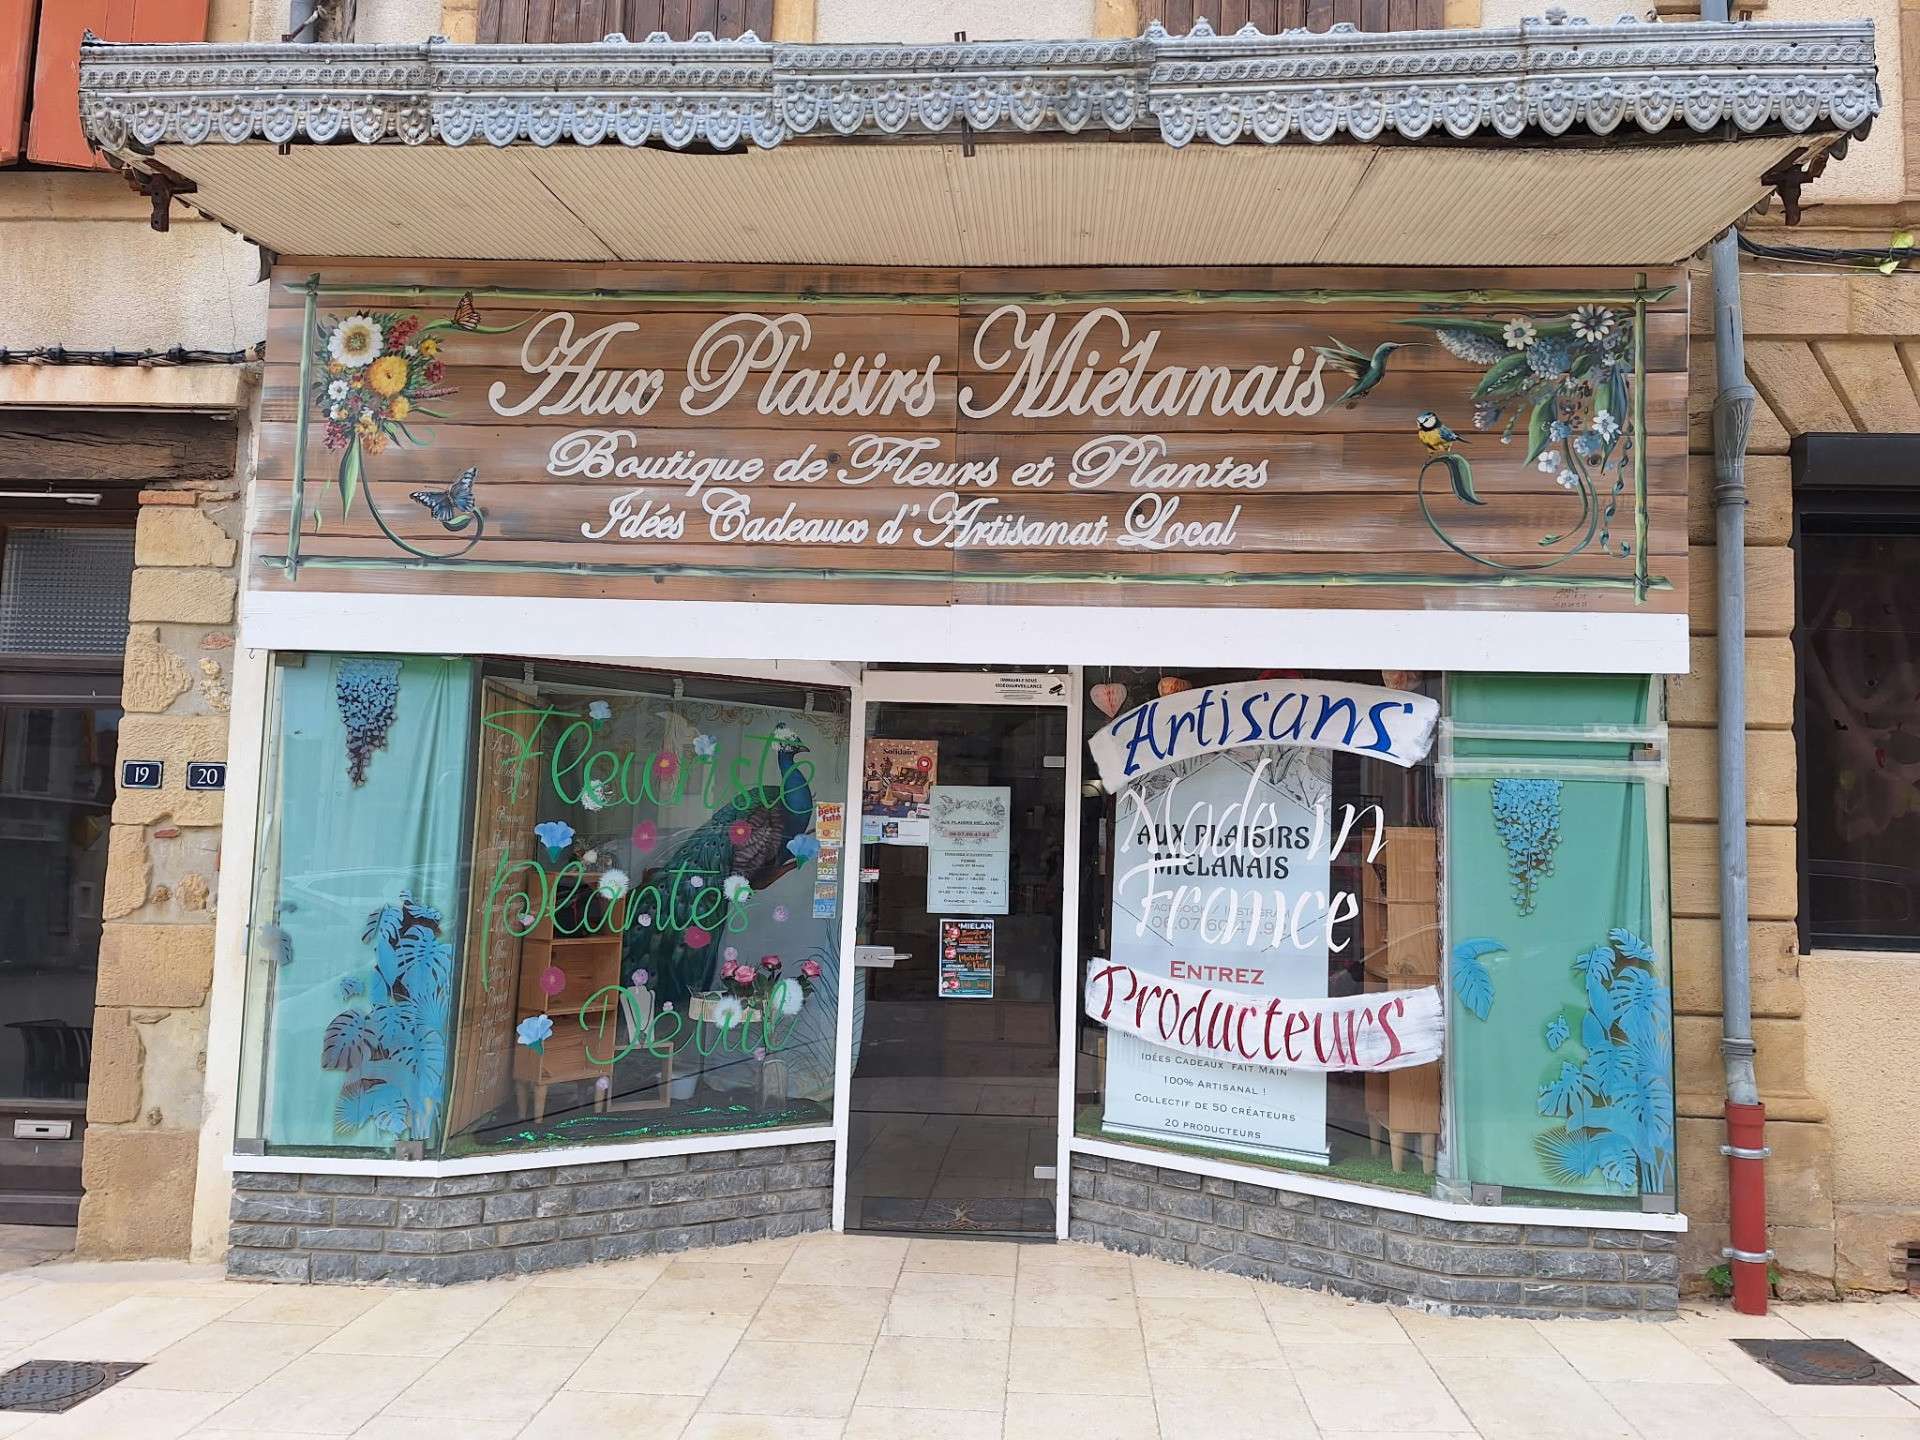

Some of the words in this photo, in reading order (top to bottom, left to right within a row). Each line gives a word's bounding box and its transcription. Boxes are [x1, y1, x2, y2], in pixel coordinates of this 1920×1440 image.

[488, 311, 665, 417] Aux
[680, 313, 941, 417] Plaisirs
[958, 304, 1327, 419] Miélanais
[548, 429, 764, 497] Boutique
[773, 444, 829, 483] de
[837, 434, 999, 488] Fleurs
[1012, 456, 1054, 488] et
[1069, 434, 1269, 489] Plantes
[581, 488, 686, 540] Idées
[701, 487, 869, 543] Cadeaux
[876, 491, 1108, 549] d'Artisanat
[1117, 492, 1242, 550] Local
[1111, 689, 1414, 777] Artisans
[134, 766, 150, 783] 19
[197, 768, 218, 785] 20
[481, 704, 817, 815] Fleuriste
[1118, 757, 1280, 860] Made
[1306, 793, 1389, 865] in
[1196, 825, 1310, 849] PLAISIRS
[1118, 855, 1360, 954] France
[1170, 960, 1264, 985] ENTREZ
[1092, 965, 1417, 1067] Producteurs
[1164, 1076, 1194, 1087] 100%
[1198, 1080, 1258, 1095] ARTISANAL
[1175, 1056, 1225, 1070] CADEAUX
[1134, 1093, 1191, 1108] COLLECTIF
[1195, 1102, 1208, 1111] DE
[1212, 1103, 1227, 1113] 50
[1231, 1106, 1297, 1122] CRÉATEURS
[1165, 1118, 1179, 1128] 20
[1183, 1121, 1262, 1139] PRODUCTEURS
